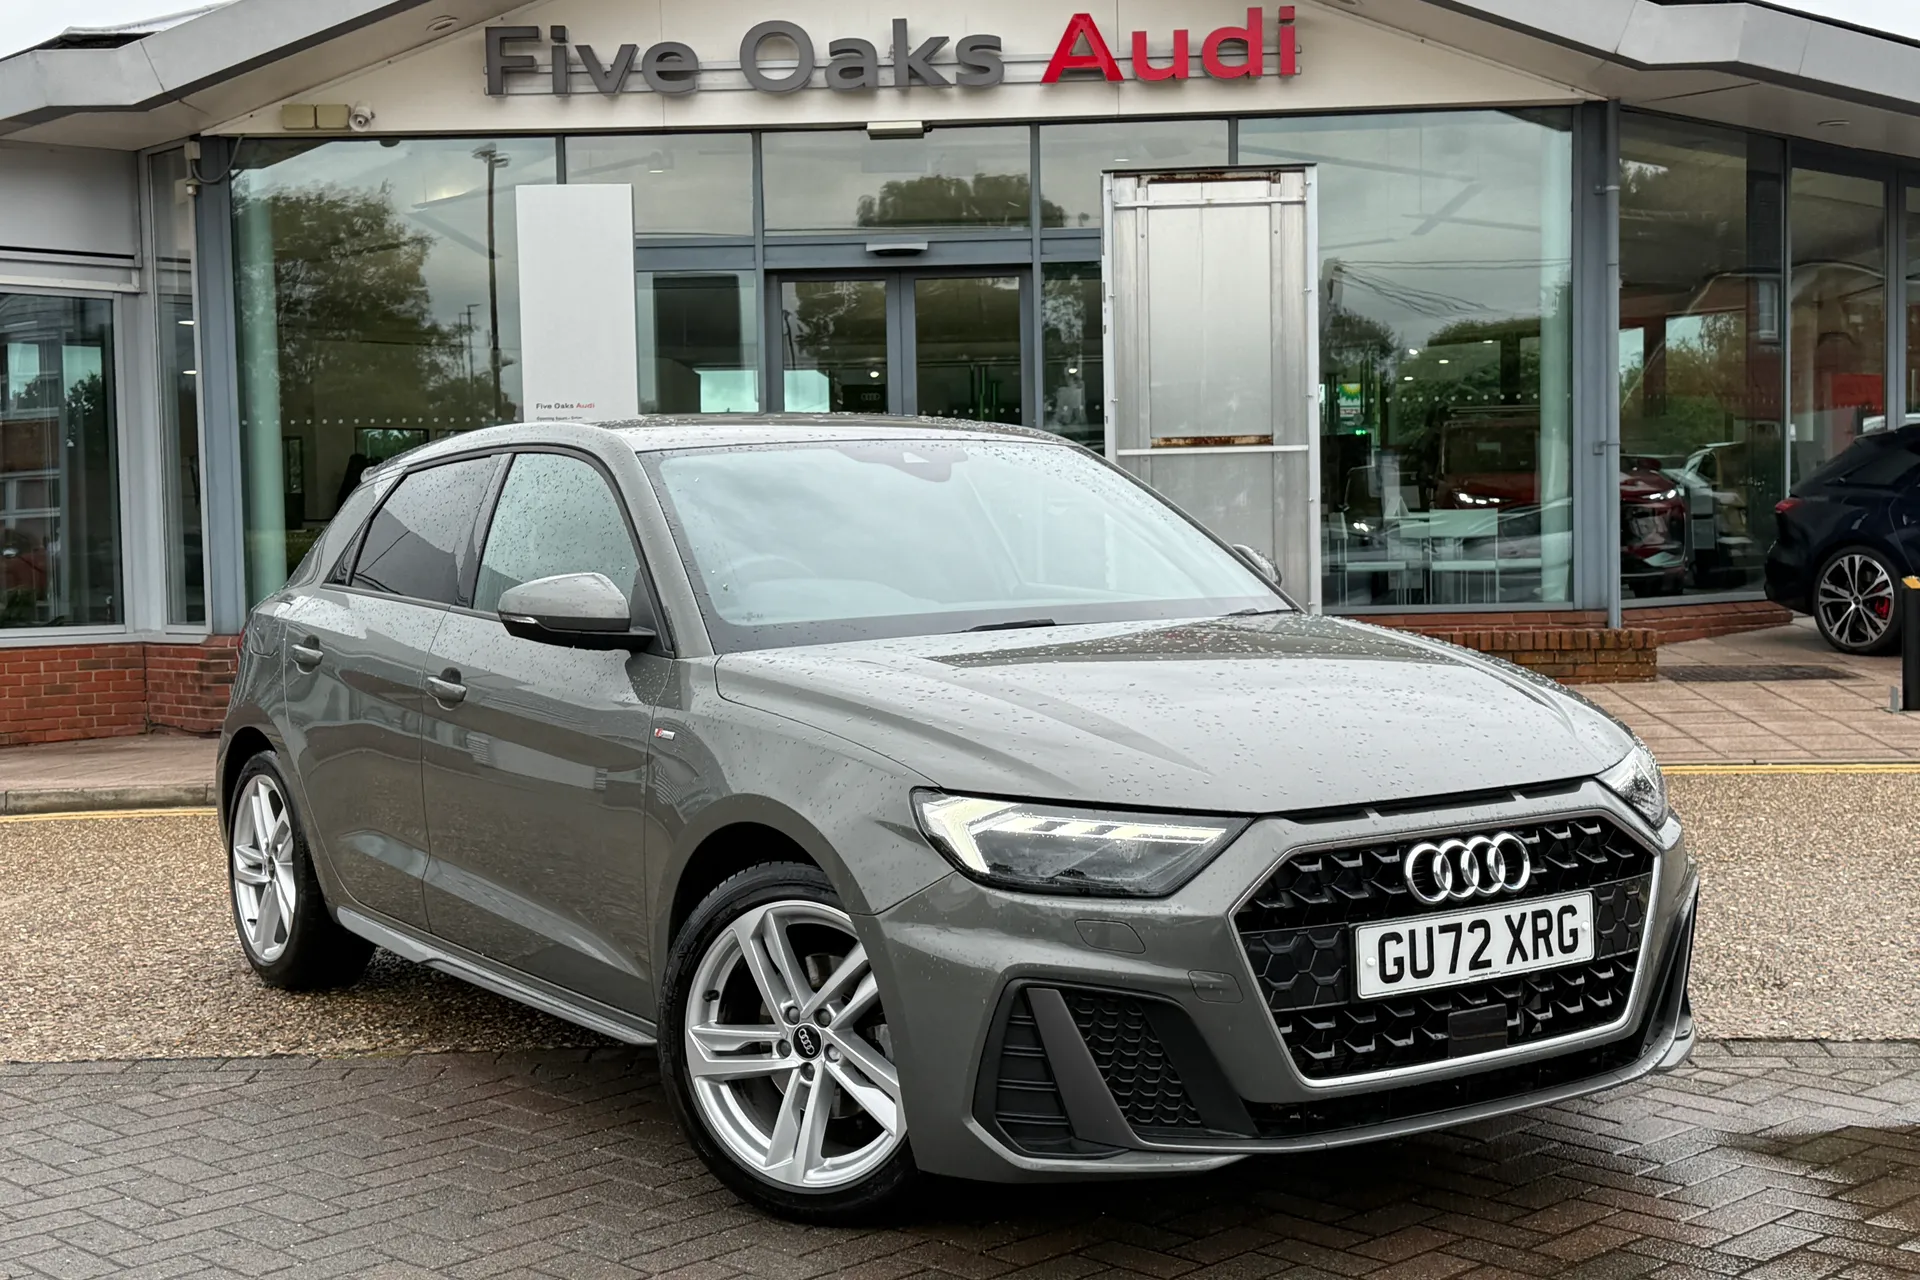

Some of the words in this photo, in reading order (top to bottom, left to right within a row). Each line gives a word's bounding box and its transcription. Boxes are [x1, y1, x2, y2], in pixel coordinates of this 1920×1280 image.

[484, 25, 701, 97] Five
[739, 18, 1005, 95] Oaks
[1040, 6, 1296, 84] Audi
[535, 402, 553, 410] Five
[1377, 918, 1493, 985] GU72
[1504, 904, 1579, 966] XRG
